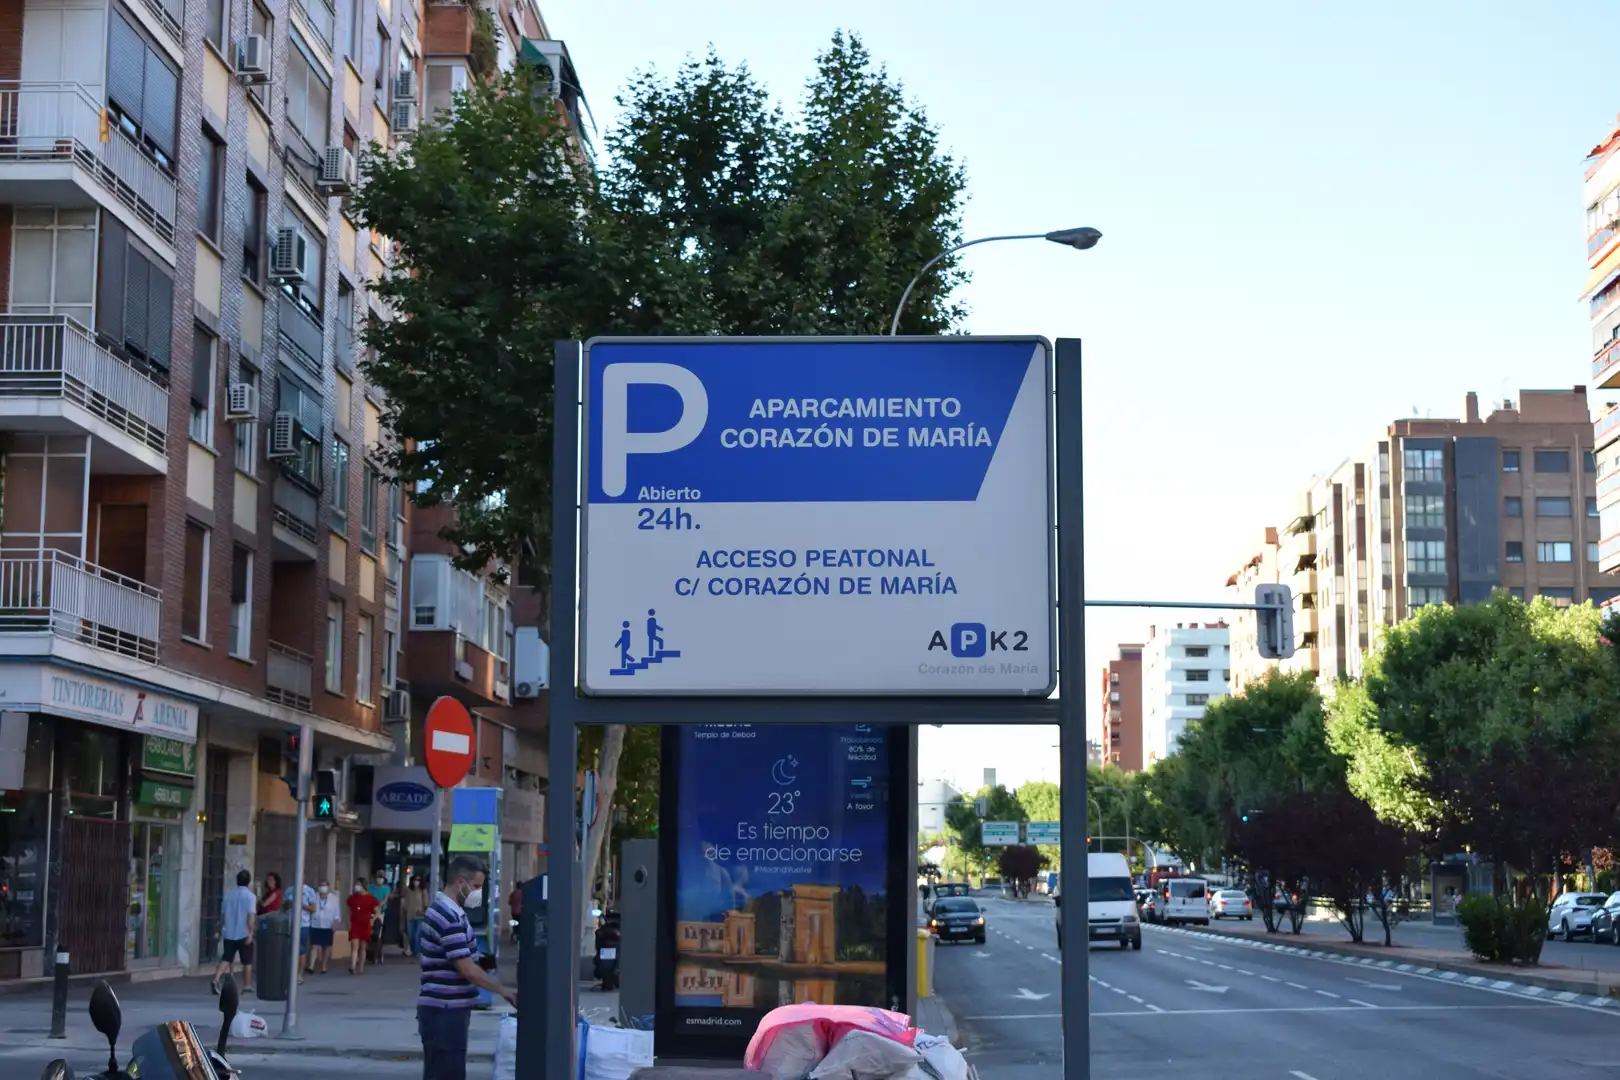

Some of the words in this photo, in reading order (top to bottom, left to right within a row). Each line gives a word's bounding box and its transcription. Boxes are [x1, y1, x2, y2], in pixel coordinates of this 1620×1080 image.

[749, 397, 961, 418] APARCAMIENTO
[602, 362, 709, 498] P
[720, 423, 853, 448] CORAZÓN
[863, 427, 899, 447] DE
[908, 422, 992, 447] MARÍA
[637, 486, 701, 500] Abierto
[637, 506, 701, 530] 24h.
[696, 550, 797, 568] ACCESO
[805, 549, 936, 567] PEATONAL
[674, 577, 700, 596] C/
[708, 572, 830, 596] CORAZÓN
[839, 577, 872, 595] DE
[880, 572, 958, 595] MARÍA
[918, 663, 975, 675] Corazón
[979, 663, 996, 675] de
[1000, 663, 1039, 675] María
[51, 676, 126, 716] TINTORERIAS
[152, 703, 188, 731] ARENAL
[380, 793, 430, 804] ARCADE
[846, 802, 853, 810] A
[855, 802, 875, 810] favor
[737, 822, 757, 840] Es
[763, 823, 830, 844] tiempo
[704, 844, 731, 861] de
[736, 845, 863, 862] emocionarse
[685, 1017, 742, 1026] esmadrid.com
